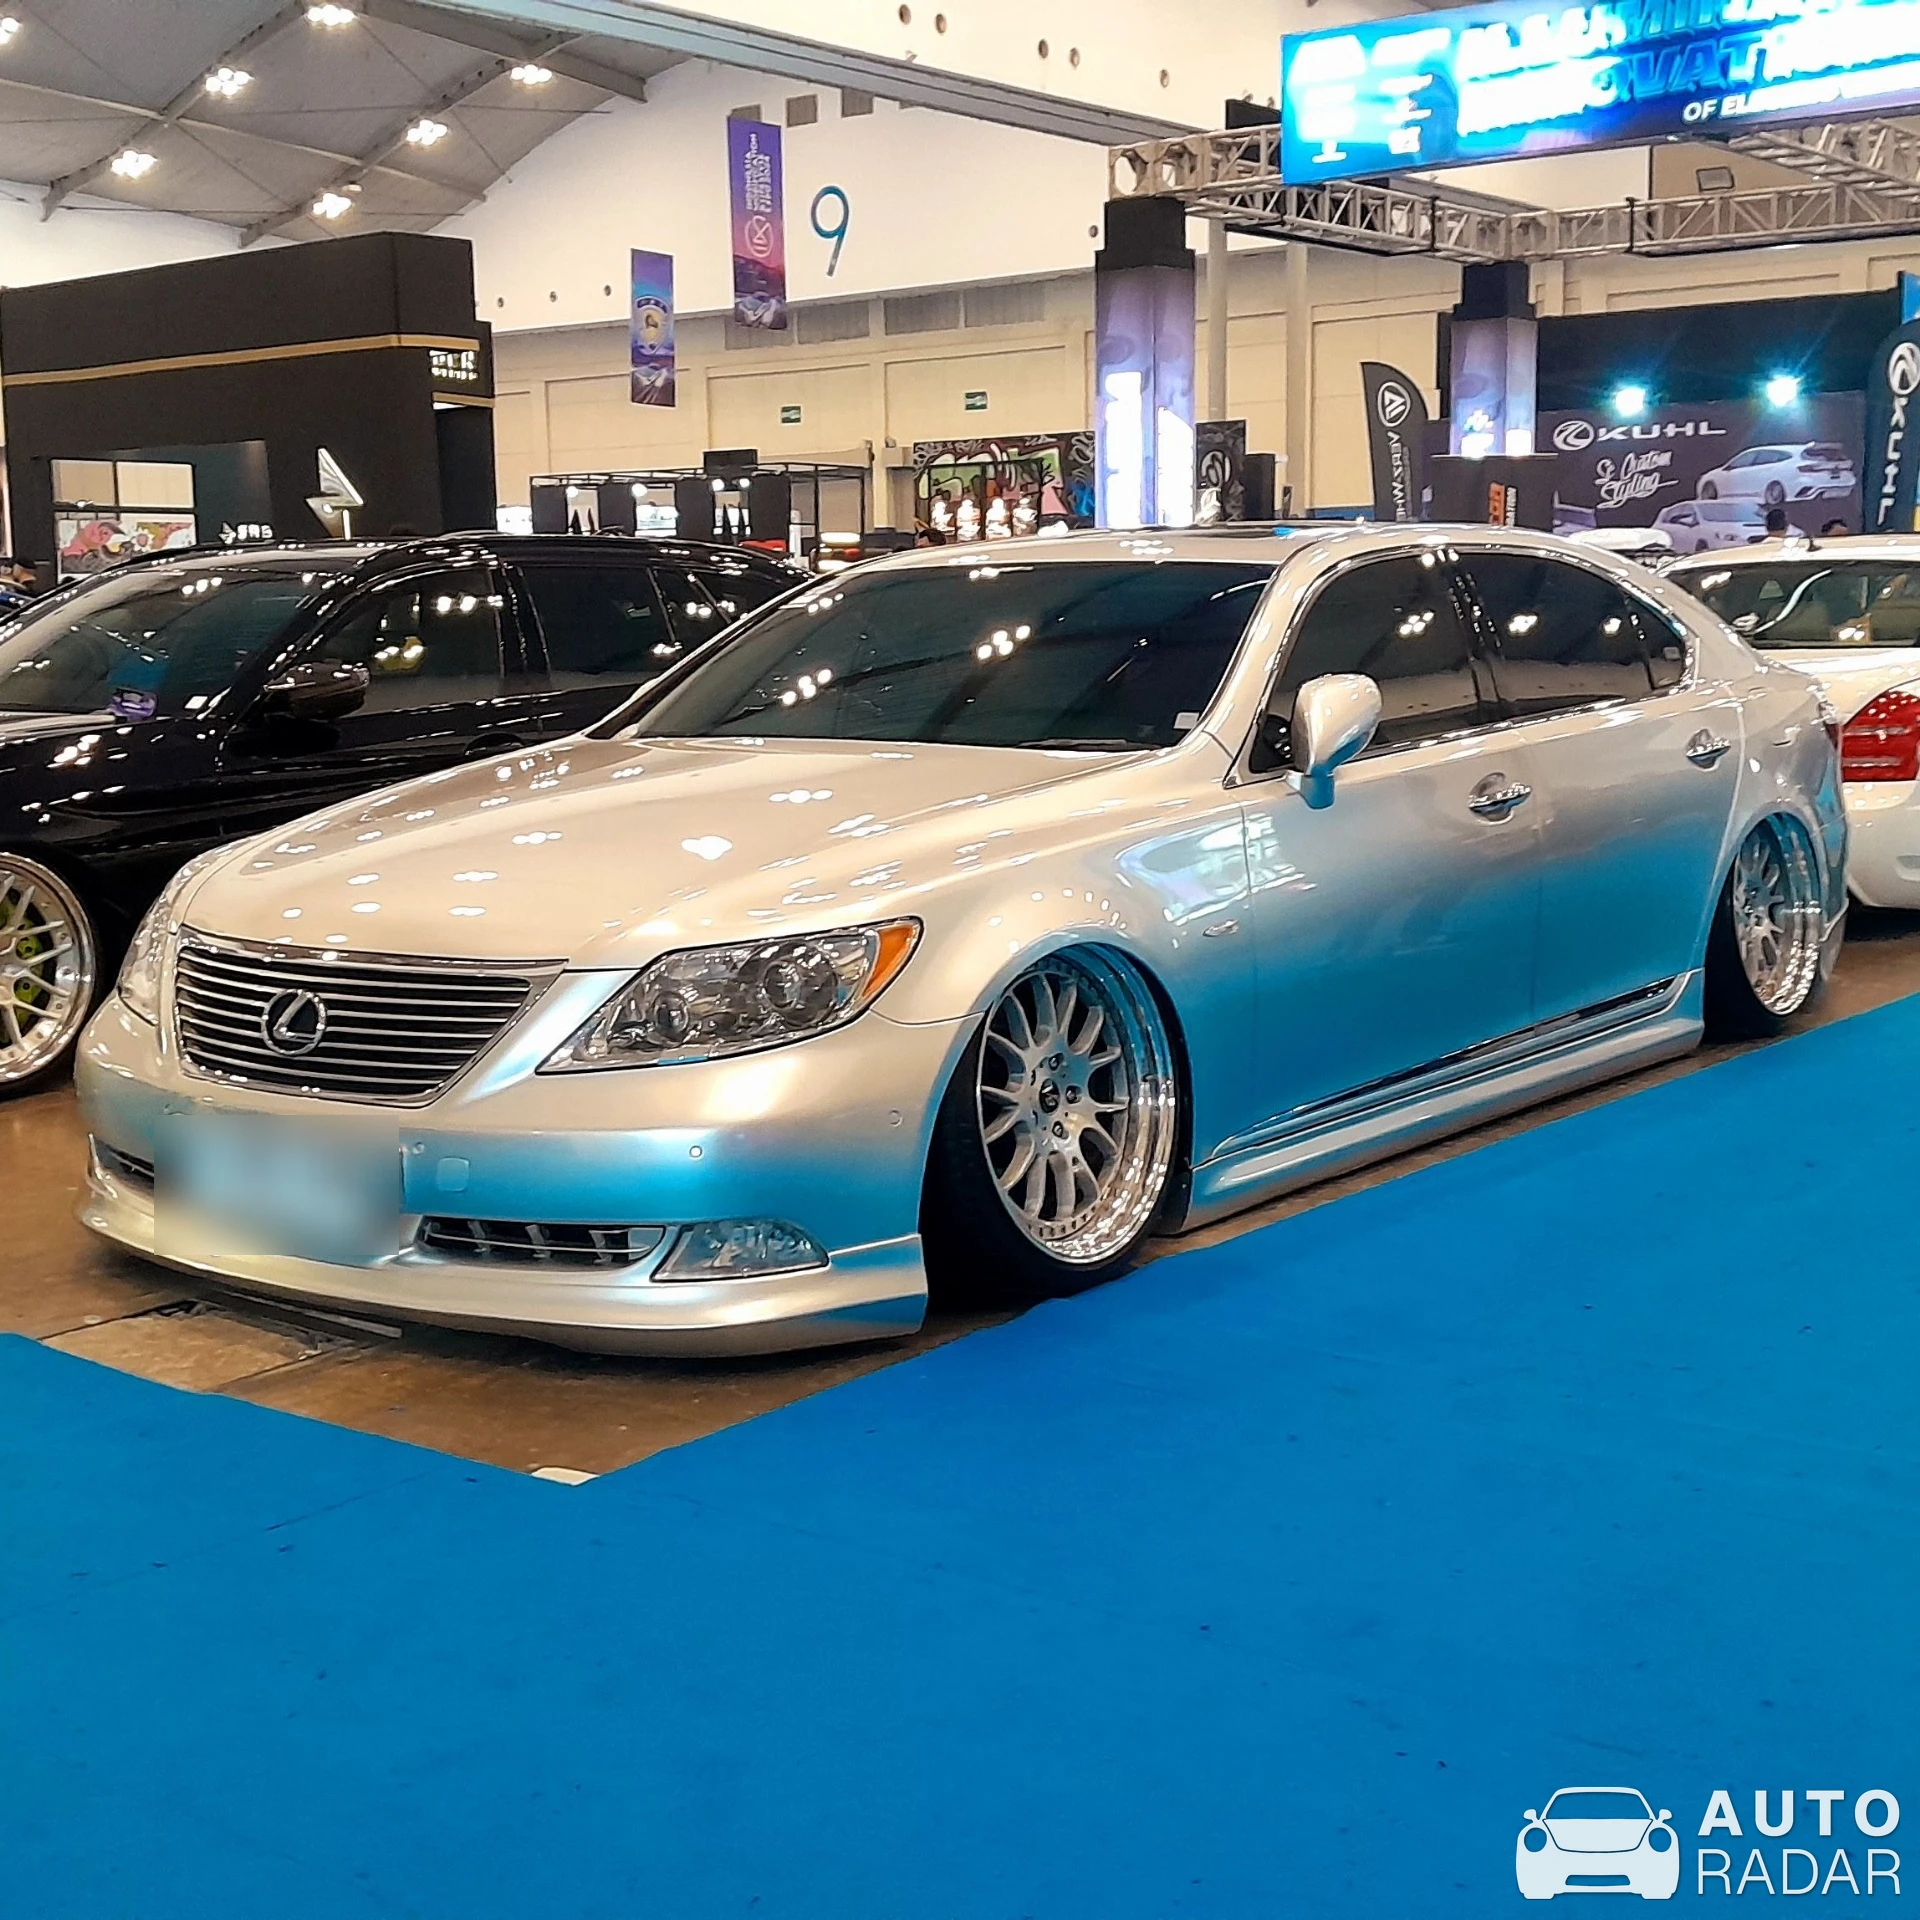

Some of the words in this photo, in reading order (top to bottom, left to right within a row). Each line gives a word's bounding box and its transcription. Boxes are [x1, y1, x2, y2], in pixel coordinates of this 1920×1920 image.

[1683, 99, 1718, 123] OF
[811, 186, 849, 276] 9
[1596, 421, 1727, 442] KUHL
